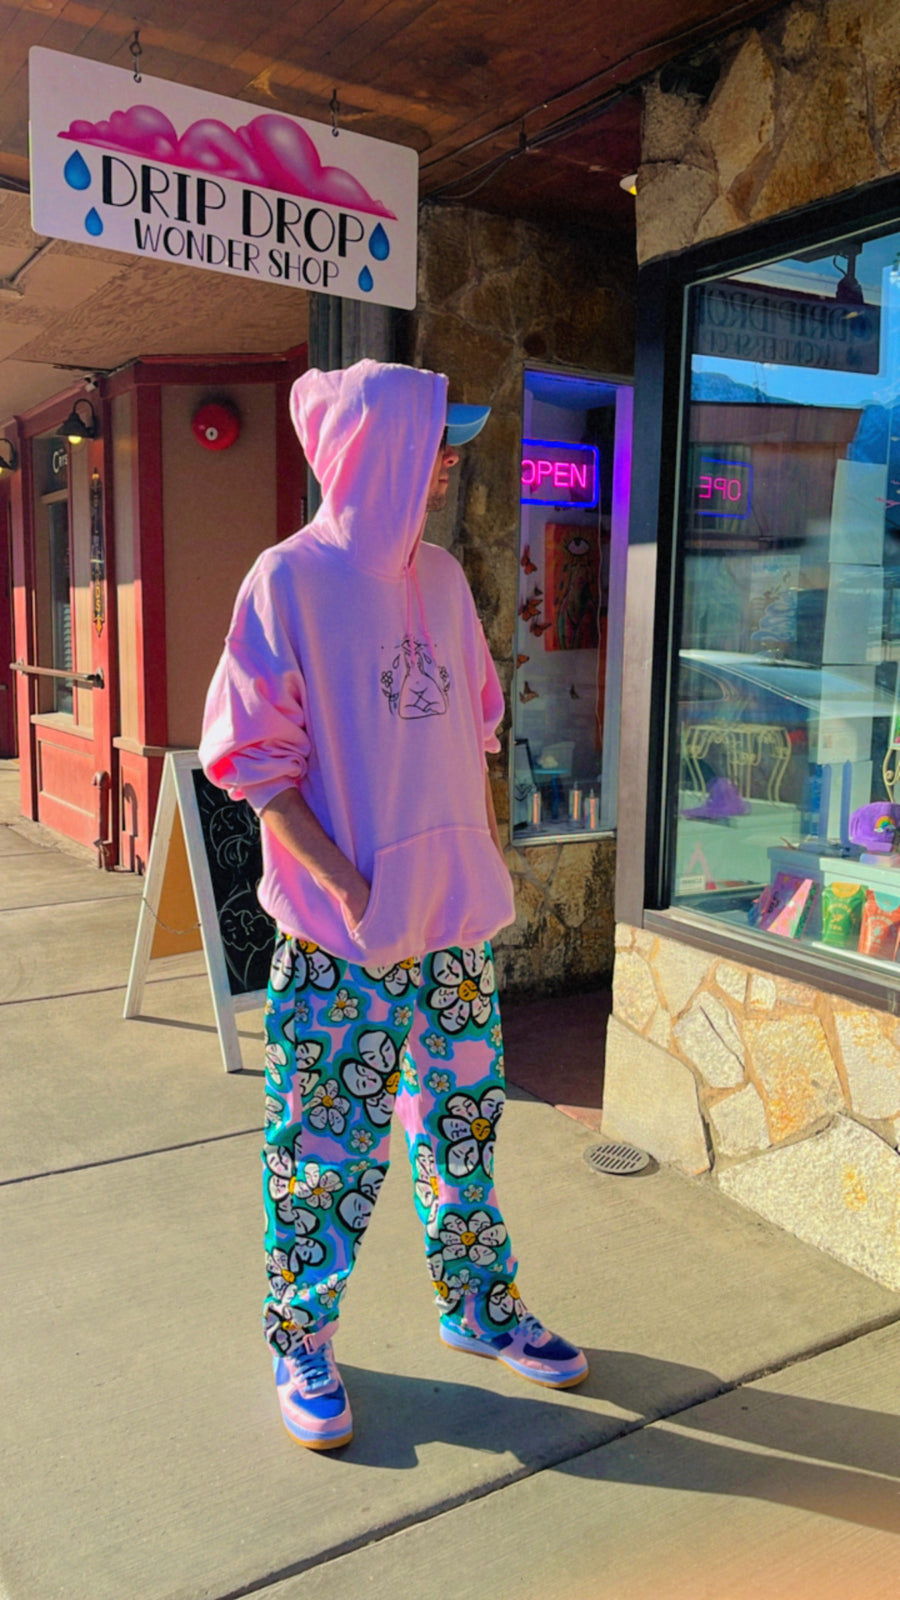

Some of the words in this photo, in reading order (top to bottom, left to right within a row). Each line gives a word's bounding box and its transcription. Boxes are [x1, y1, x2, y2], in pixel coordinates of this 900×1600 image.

[102, 155, 225, 226] DRIP
[242, 189, 364, 258] DROP
[134, 218, 260, 274] WONDER
[268, 248, 340, 288] SHOP
[520, 459, 587, 488] OPEN
